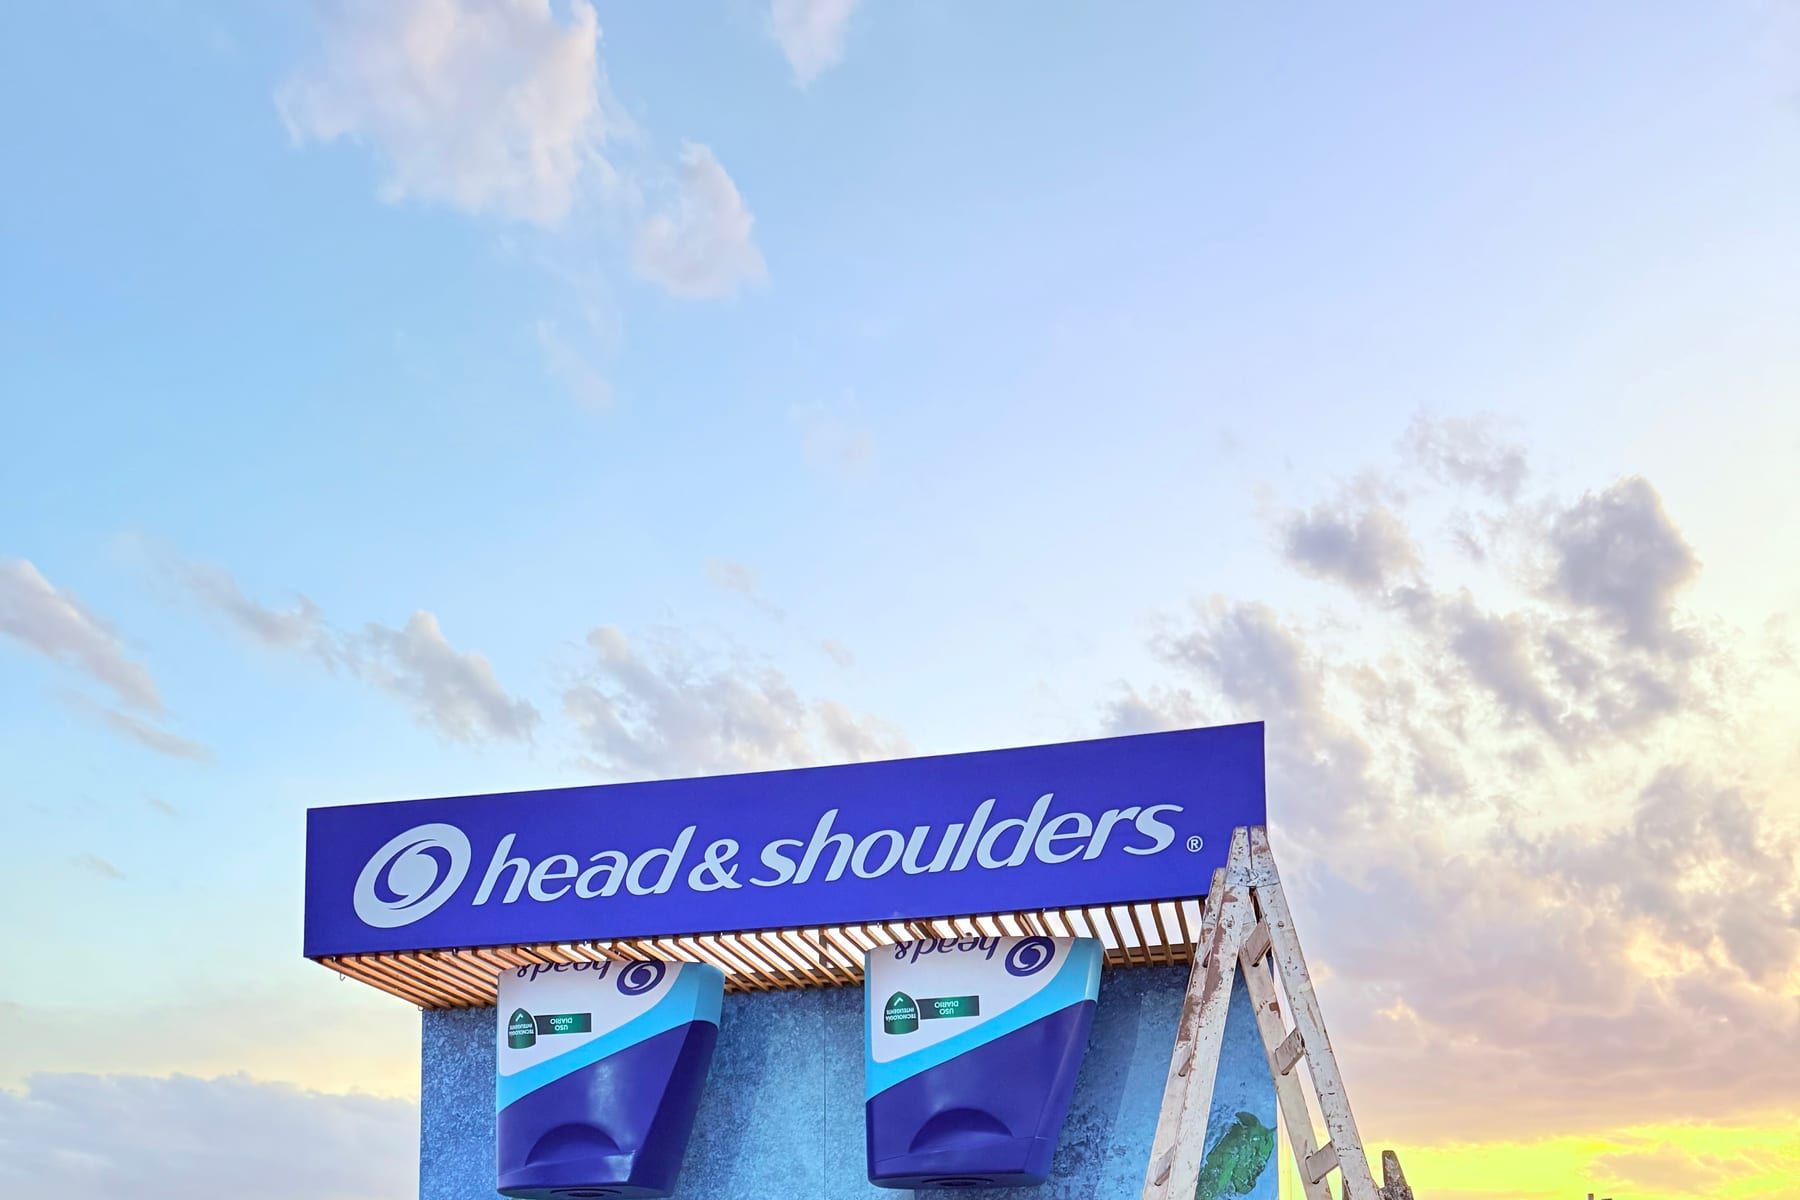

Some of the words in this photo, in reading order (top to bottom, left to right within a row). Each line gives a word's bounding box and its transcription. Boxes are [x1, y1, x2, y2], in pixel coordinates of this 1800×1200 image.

[471, 833, 697, 906] head
[749, 793, 1184, 887] shoulders
[934, 1000, 959, 1008] DIARIO
[939, 1008, 954, 1016] USO
[550, 1017, 573, 1025] DIARIO
